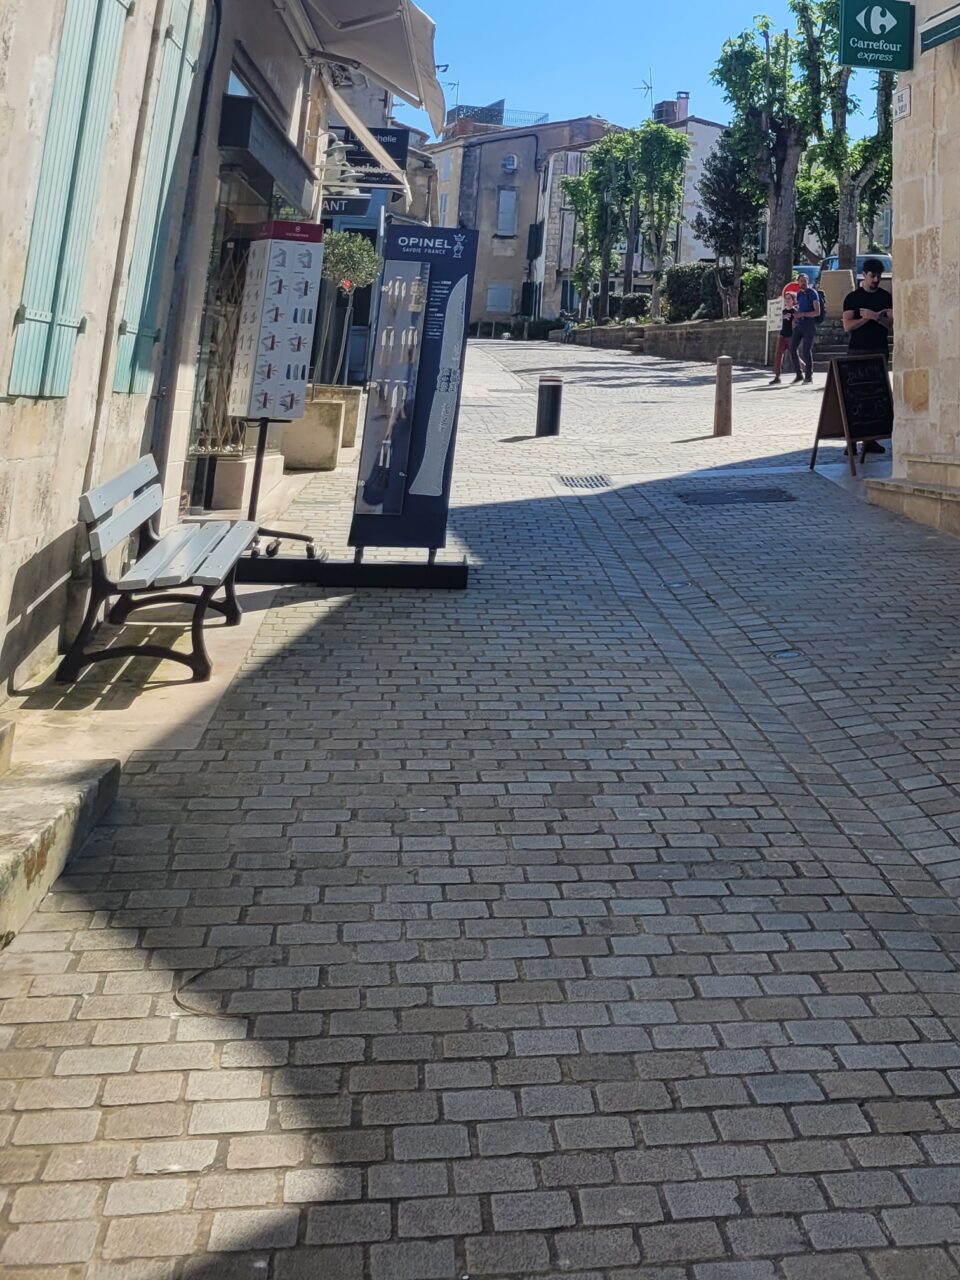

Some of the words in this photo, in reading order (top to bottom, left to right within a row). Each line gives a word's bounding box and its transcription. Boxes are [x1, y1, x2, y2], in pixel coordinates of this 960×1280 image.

[849, 37, 902, 51] Carrefour
[857, 51, 893, 62] express
[398, 236, 452, 249] OPINEL
